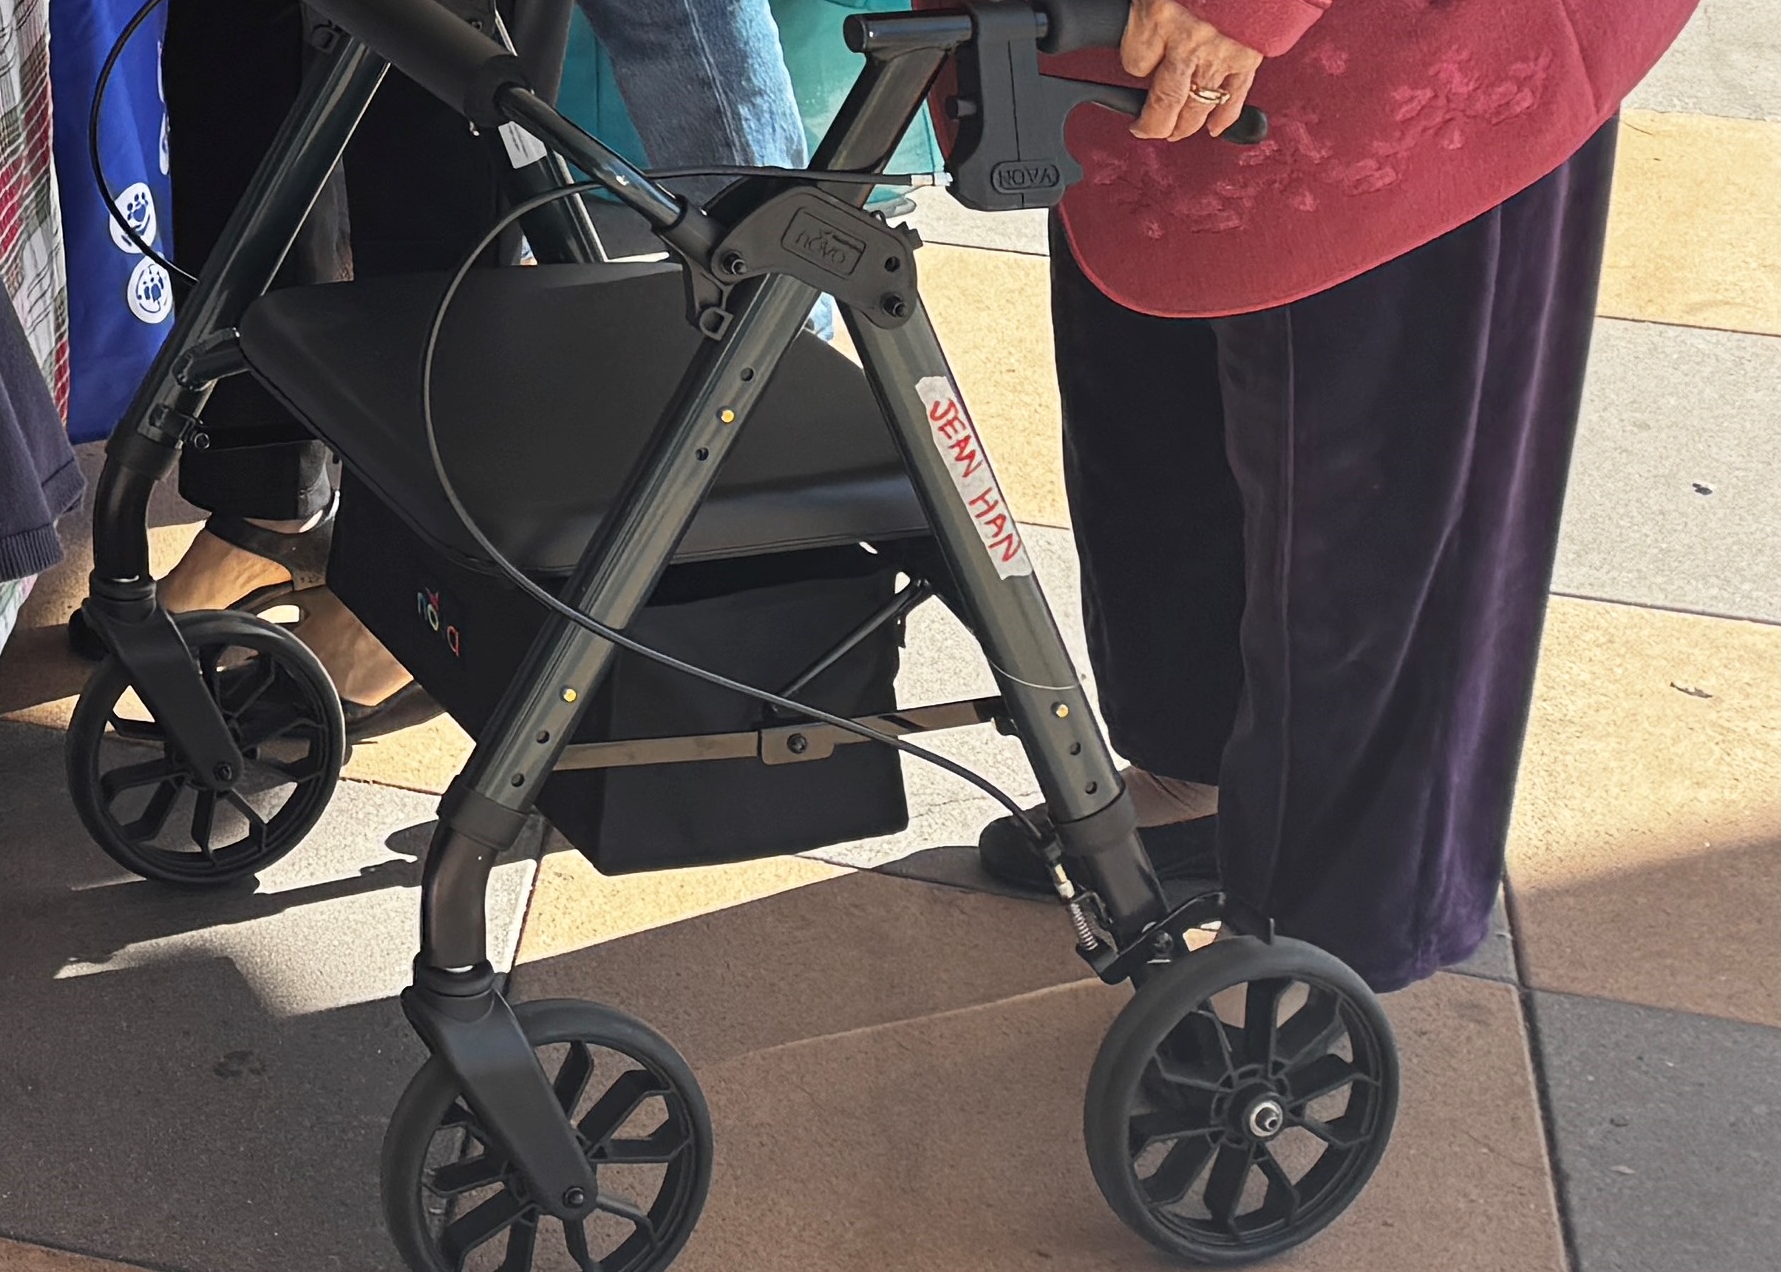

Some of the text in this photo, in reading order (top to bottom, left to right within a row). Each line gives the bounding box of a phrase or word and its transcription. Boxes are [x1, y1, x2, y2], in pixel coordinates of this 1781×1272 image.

[998, 166, 1053, 187] NOVA
[929, 397, 1023, 562] JEAN HAN
